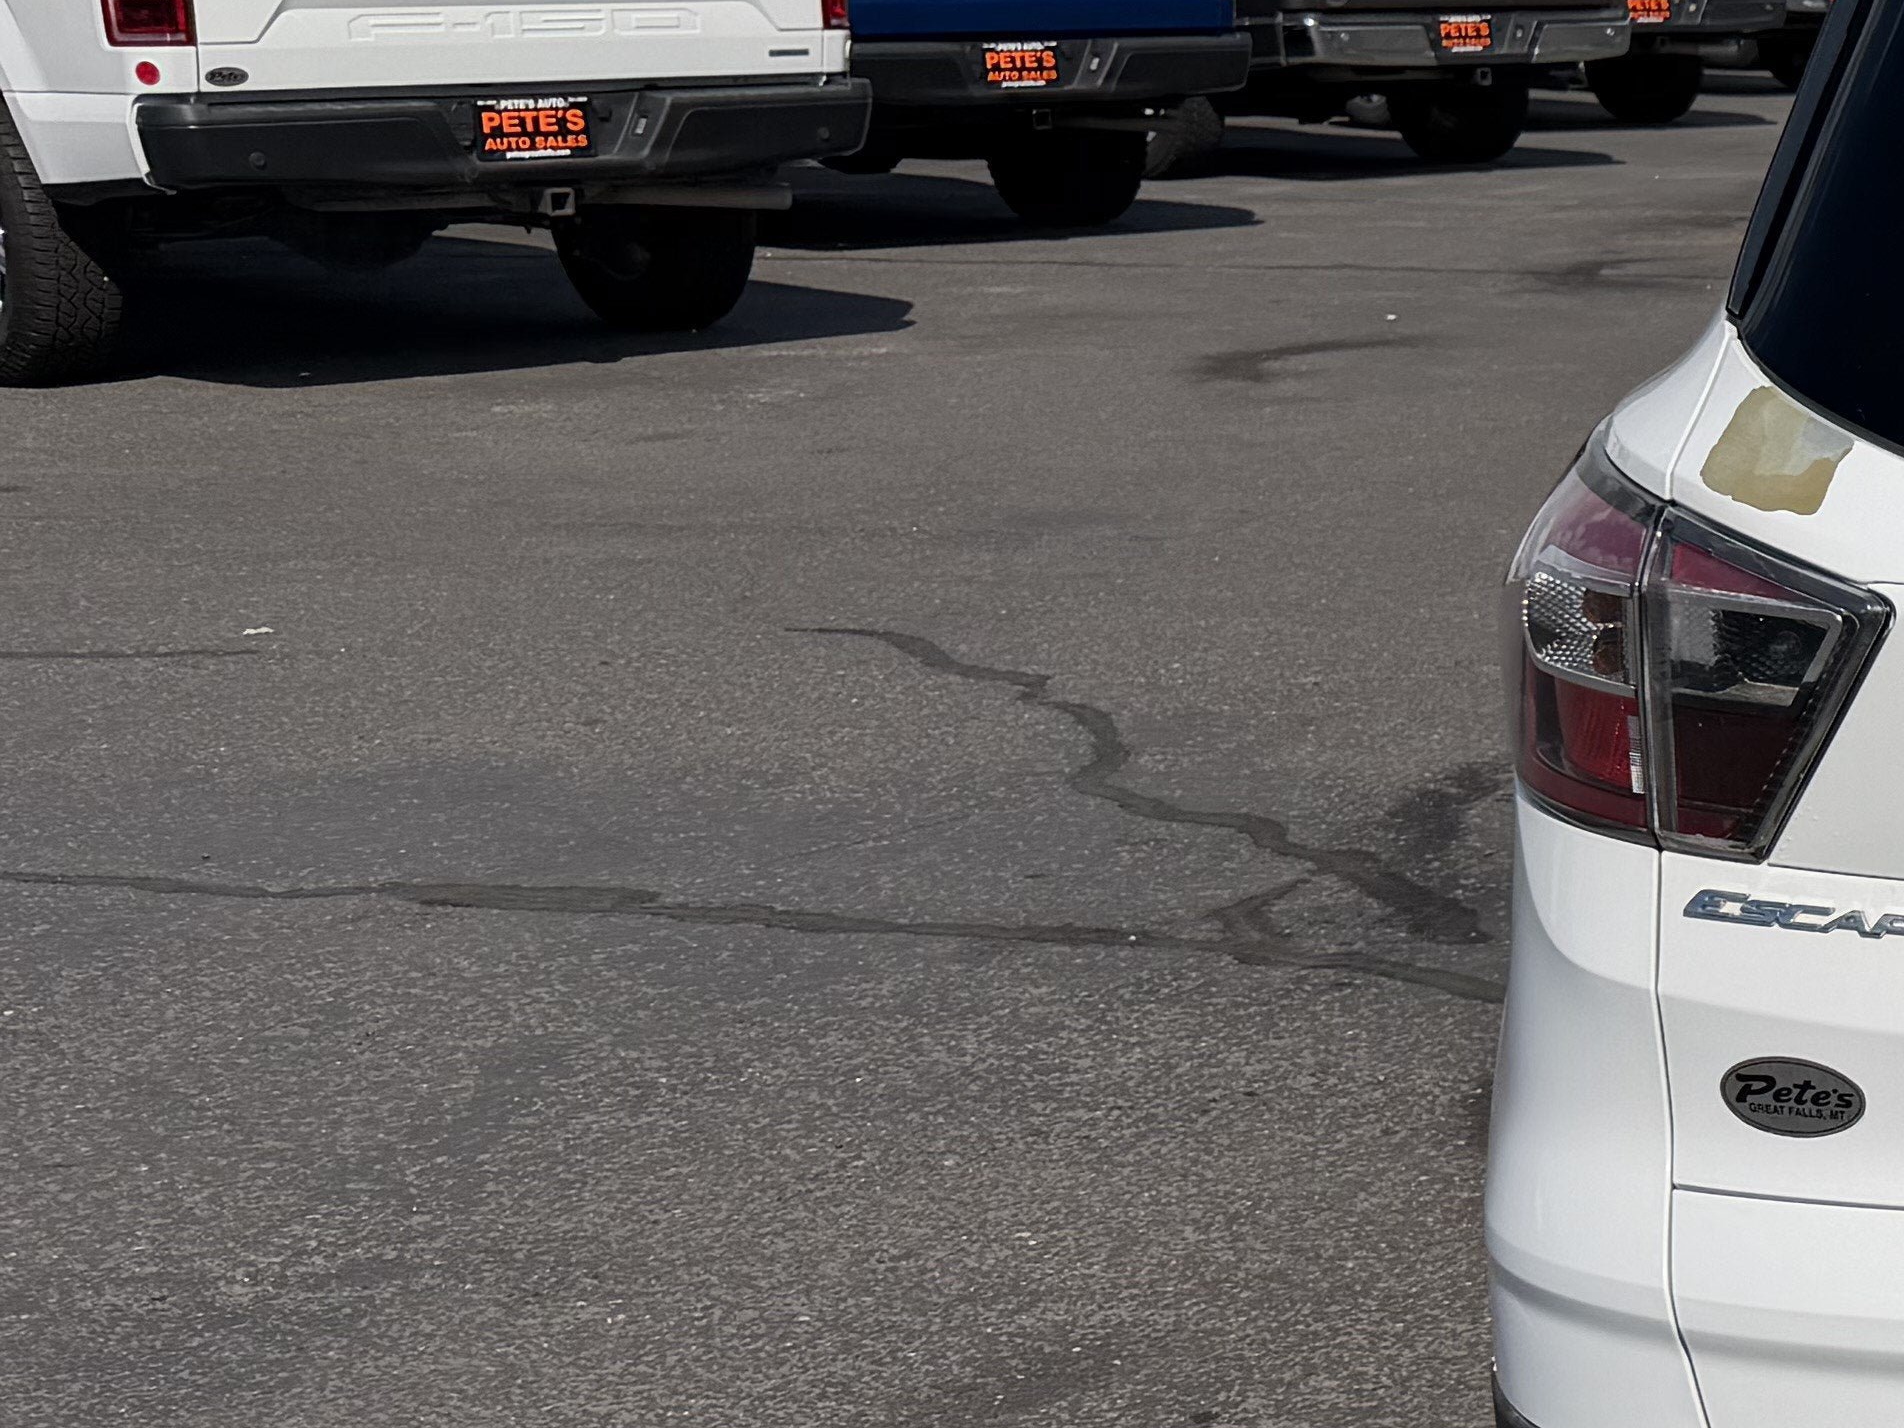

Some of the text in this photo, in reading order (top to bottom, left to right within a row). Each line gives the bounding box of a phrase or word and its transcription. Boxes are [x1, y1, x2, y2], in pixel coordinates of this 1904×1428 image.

[347, 8, 700, 41] F-150
[1440, 22, 1490, 38] PETE'S
[985, 50, 1056, 69] PETE'S
[481, 108, 585, 134] PETE'S
[485, 134, 589, 151] AUTO SALES
[1735, 1072, 1855, 1109] Pete's
[1749, 1102, 1785, 1116] GREAT
[1829, 1109, 1846, 1121] MT
